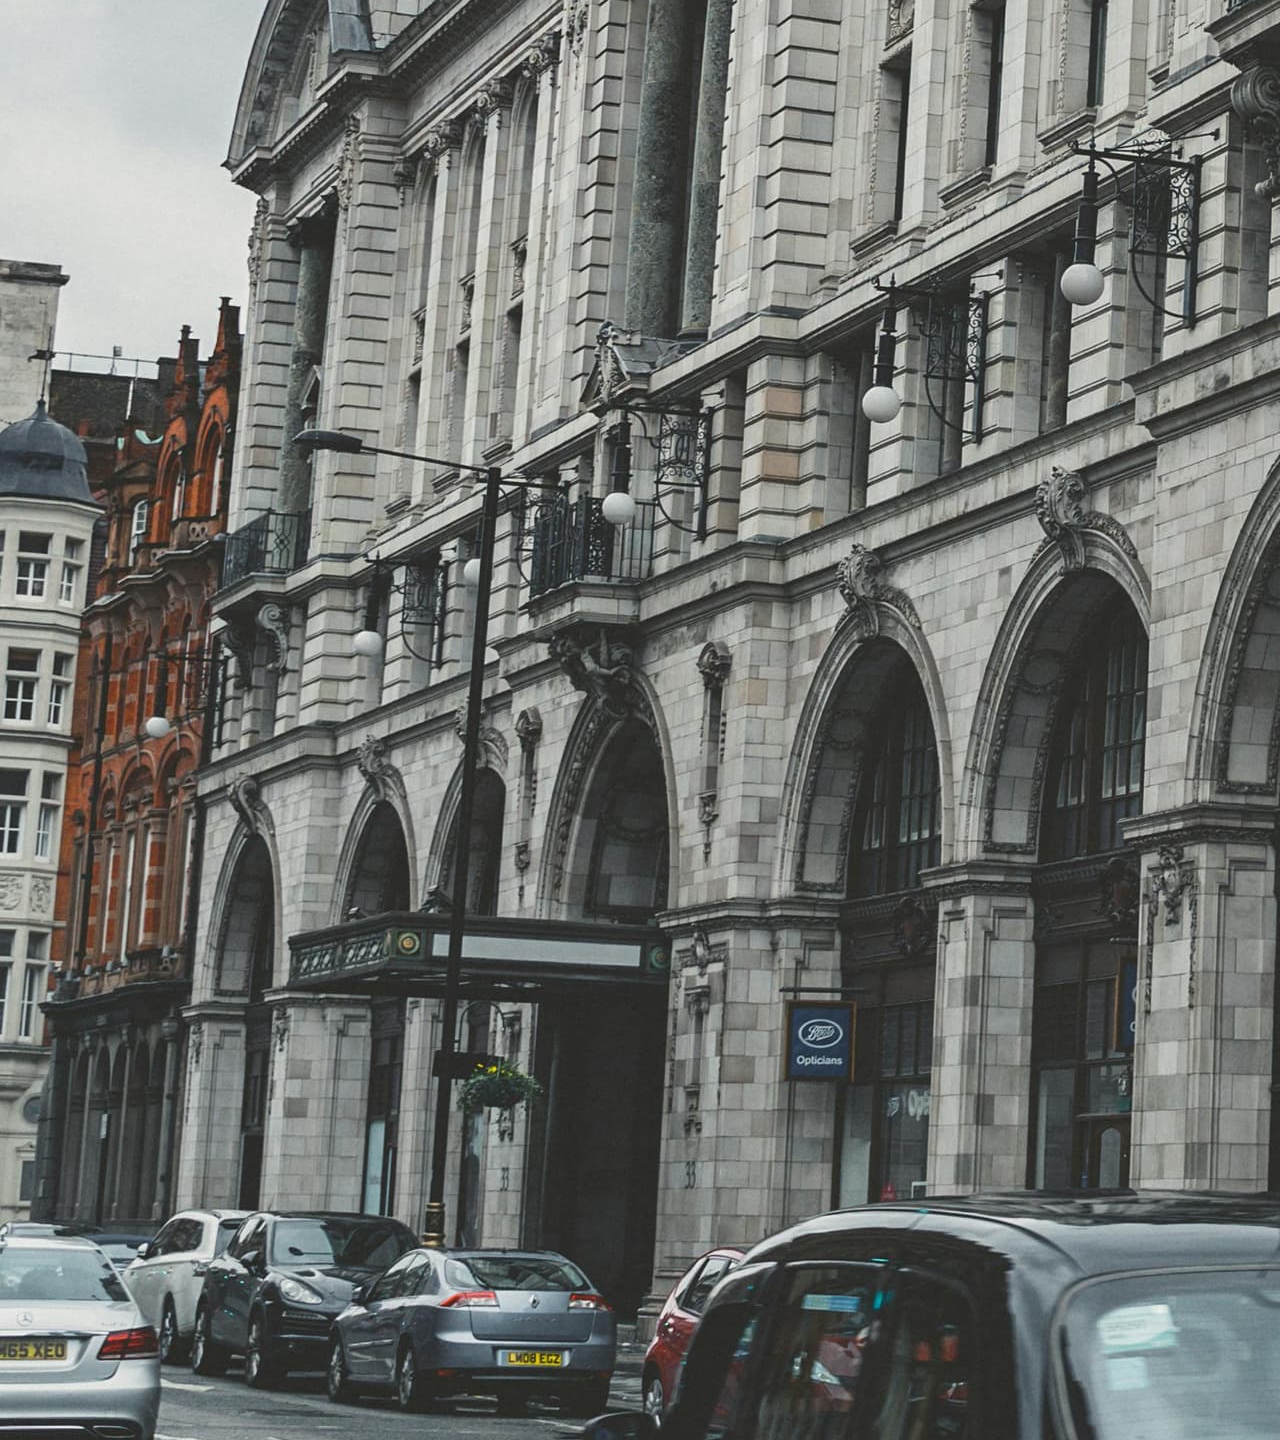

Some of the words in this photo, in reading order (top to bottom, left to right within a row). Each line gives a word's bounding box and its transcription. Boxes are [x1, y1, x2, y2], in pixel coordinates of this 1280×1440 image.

[804, 1025, 836, 1041] Boots
[796, 1055, 842, 1066] Opticians
[500, 1167, 510, 1192] 33
[685, 1161, 696, 1189] 33
